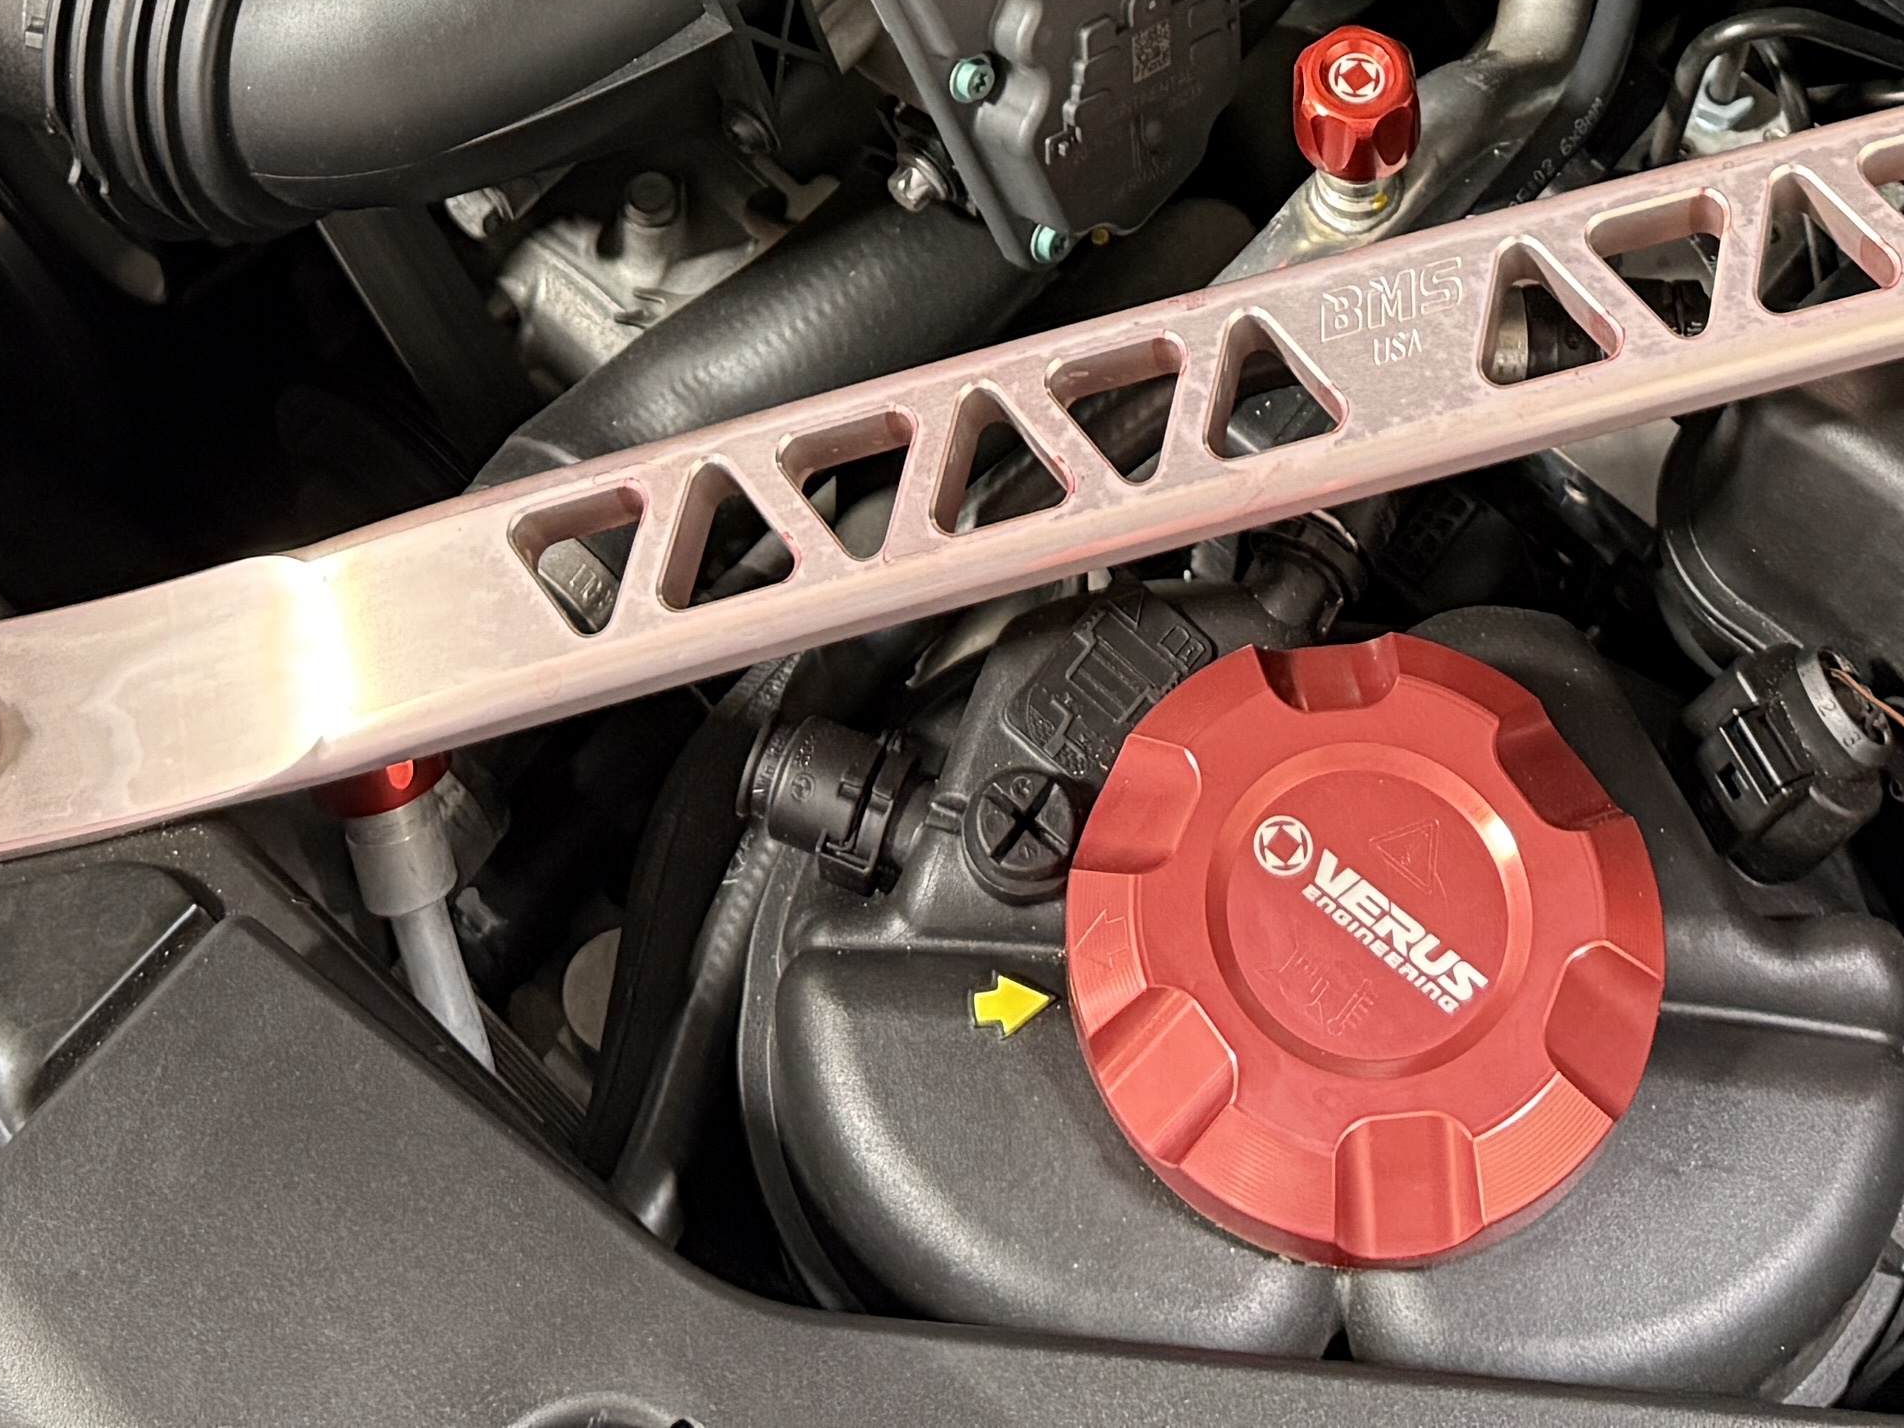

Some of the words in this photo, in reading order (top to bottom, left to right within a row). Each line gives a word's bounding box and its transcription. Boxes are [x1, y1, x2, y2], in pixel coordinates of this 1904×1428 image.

[1319, 256, 1463, 343] BMS
[1372, 328, 1423, 366] USA
[1314, 848, 1489, 1002] VERUS
